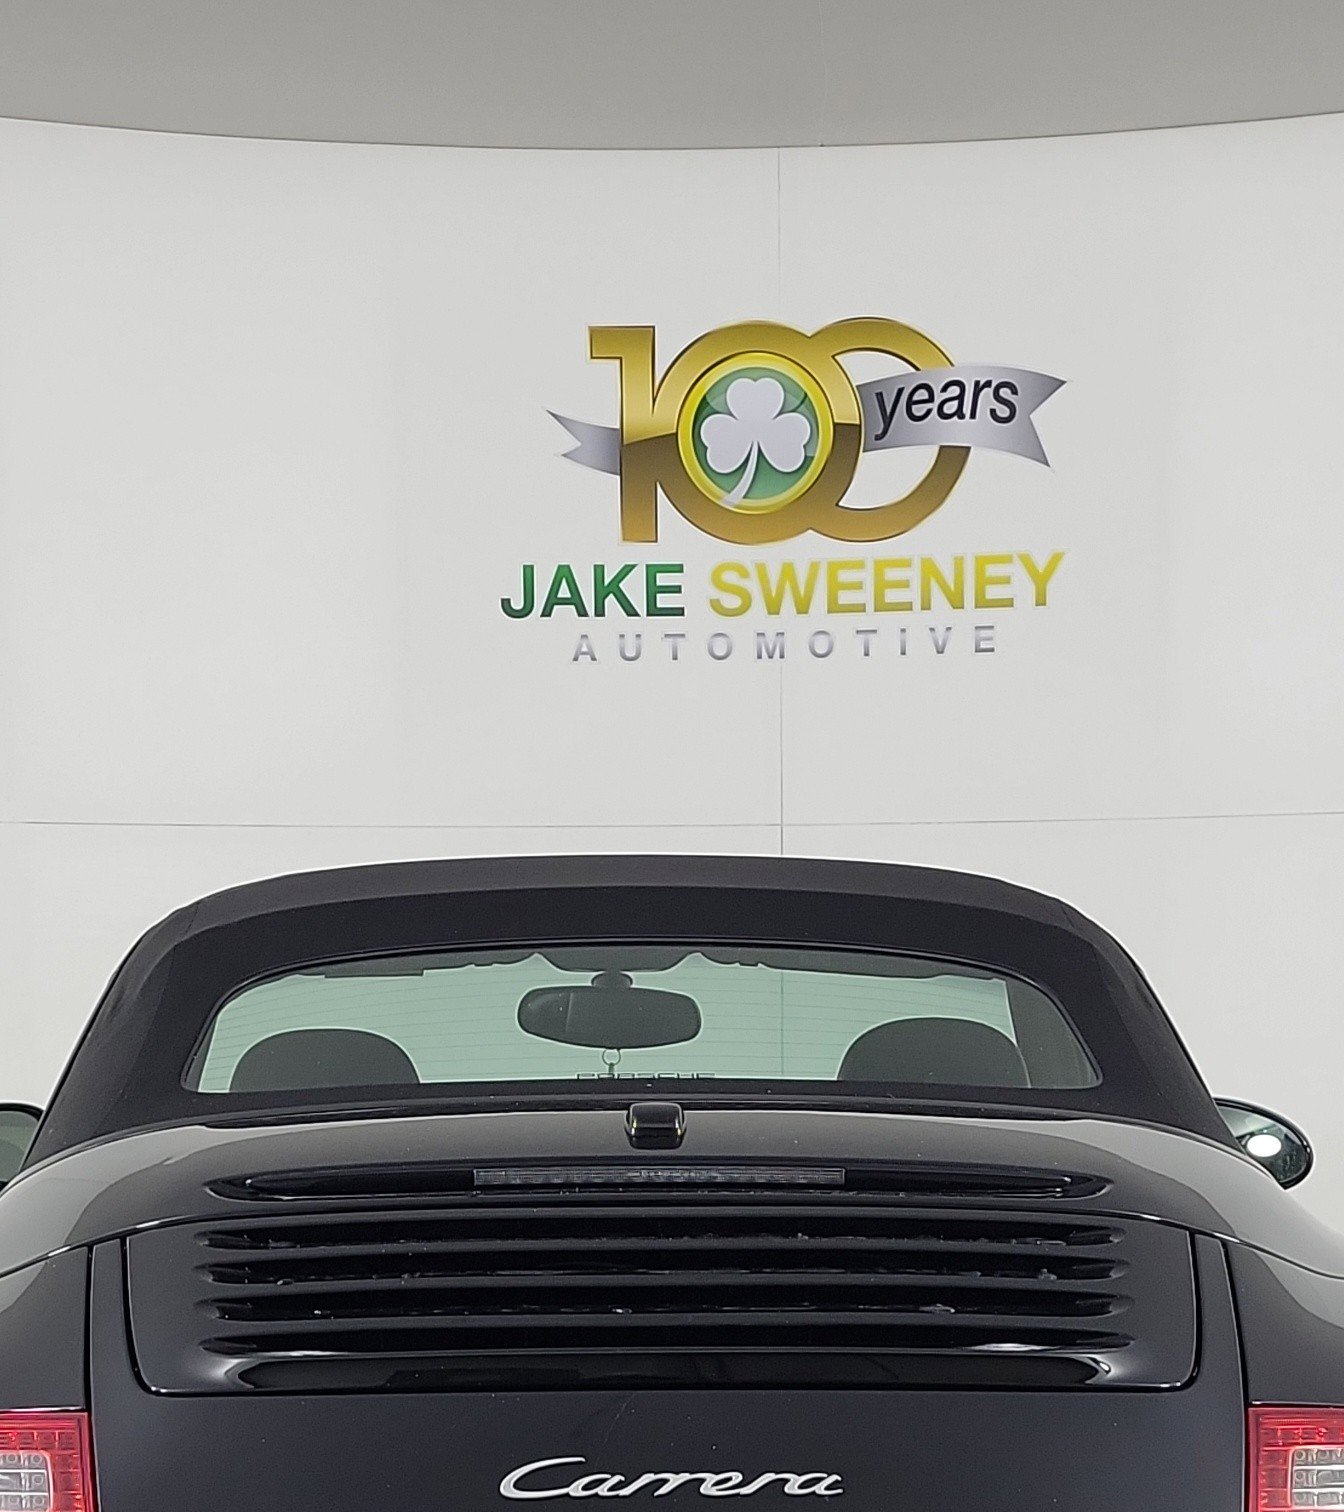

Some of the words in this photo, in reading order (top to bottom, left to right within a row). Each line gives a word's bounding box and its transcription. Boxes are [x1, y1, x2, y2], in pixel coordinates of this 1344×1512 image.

[588, 316, 972, 546] 100
[873, 379, 1019, 442] years
[501, 563, 685, 619] JAKE
[709, 551, 1064, 618] SWEENEY
[572, 625, 996, 663] AUTOMOTIVE
[499, 1456, 844, 1499] Carrera
